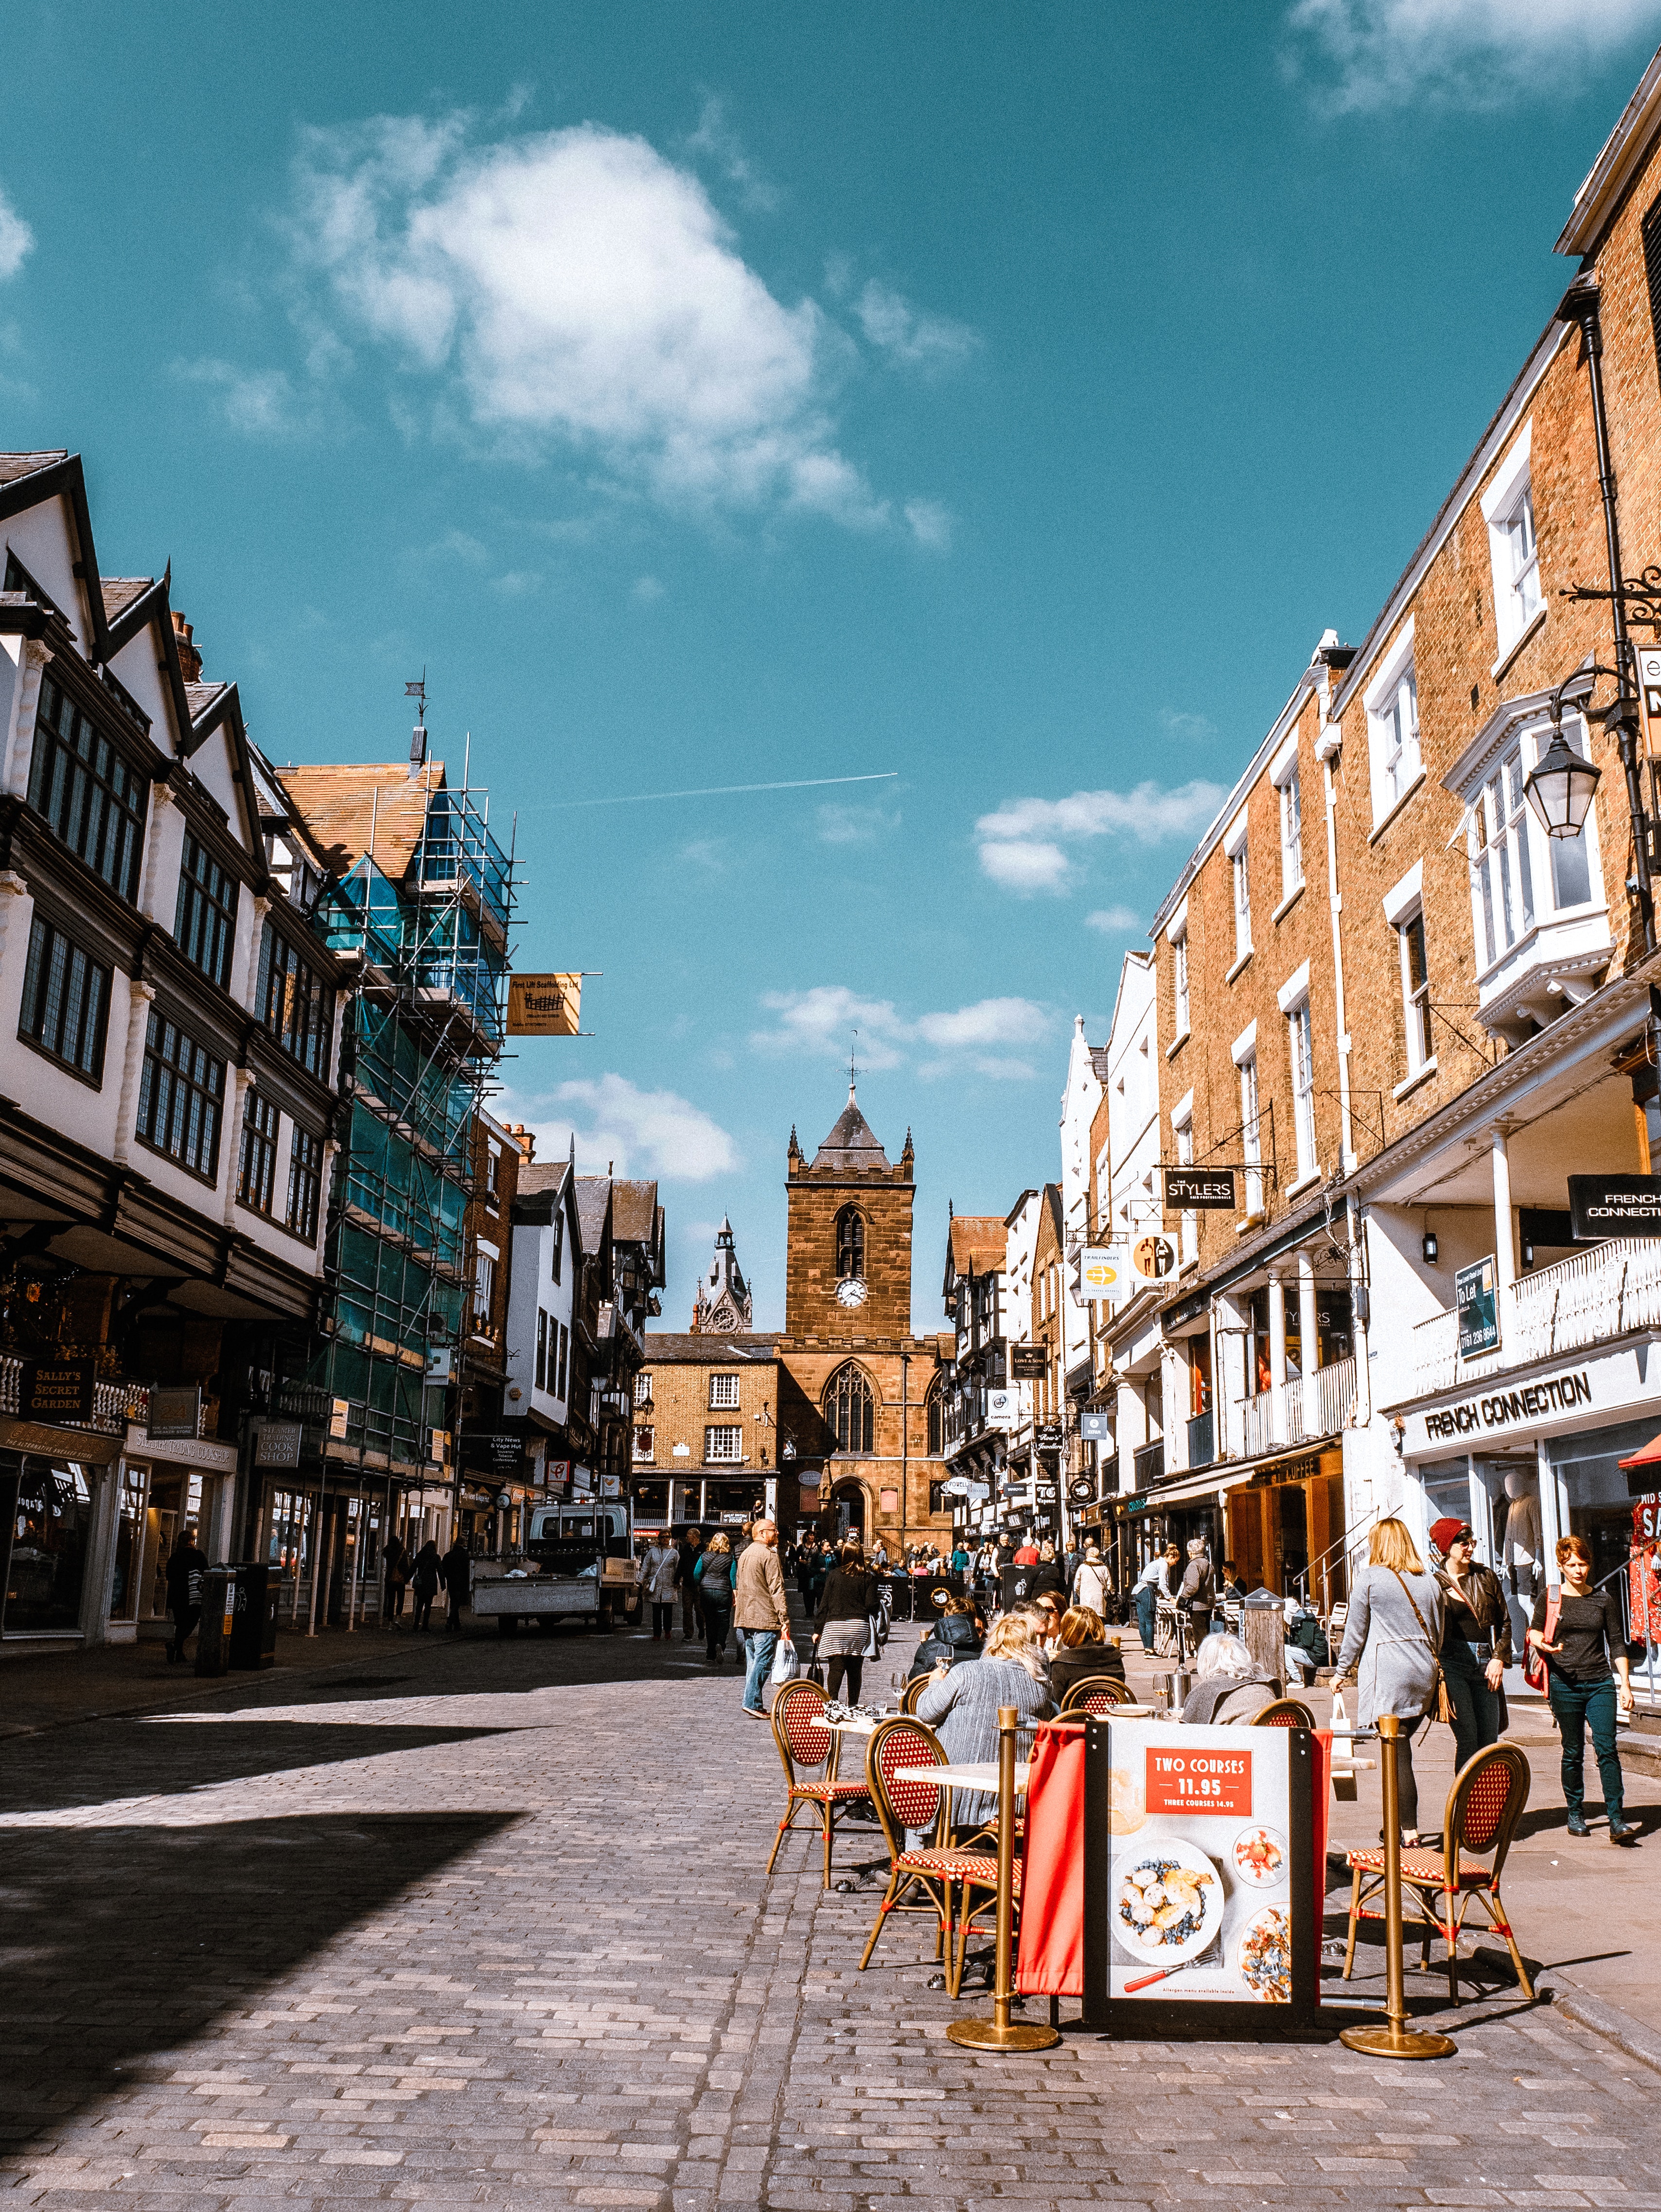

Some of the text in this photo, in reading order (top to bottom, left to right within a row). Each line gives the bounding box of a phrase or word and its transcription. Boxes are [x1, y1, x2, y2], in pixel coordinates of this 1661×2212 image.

[537, 981, 567, 990] Scaffolding
[1168, 1184, 1231, 1196] STYLERS
[1605, 1194, 1661, 1203] FRENCH
[1458, 1283, 1477, 1305] To Let
[1461, 1325, 1496, 1349] 0161 236 8644
[35, 1369, 81, 1381] SALLY'S
[35, 1383, 80, 1395] SECRET
[31, 1397, 81, 1409] GARDEN
[1425, 1371, 1591, 1440] FRENCH CONNECTION
[160, 1404, 187, 1419] 24
[17, 1440, 52, 1452] ALTERNATIVE
[53, 1448, 77, 1456] SNEAKER
[169, 1439, 195, 1458] TRADING
[197, 1446, 230, 1464] COOKSHOP
[261, 1442, 294, 1452] COOK
[260, 1452, 294, 1462] SHOP
[1641, 1493, 1655, 1504] MID
[1155, 1757, 1244, 1774] TWO COURSES
[1178, 1778, 1221, 1796] 11.95
